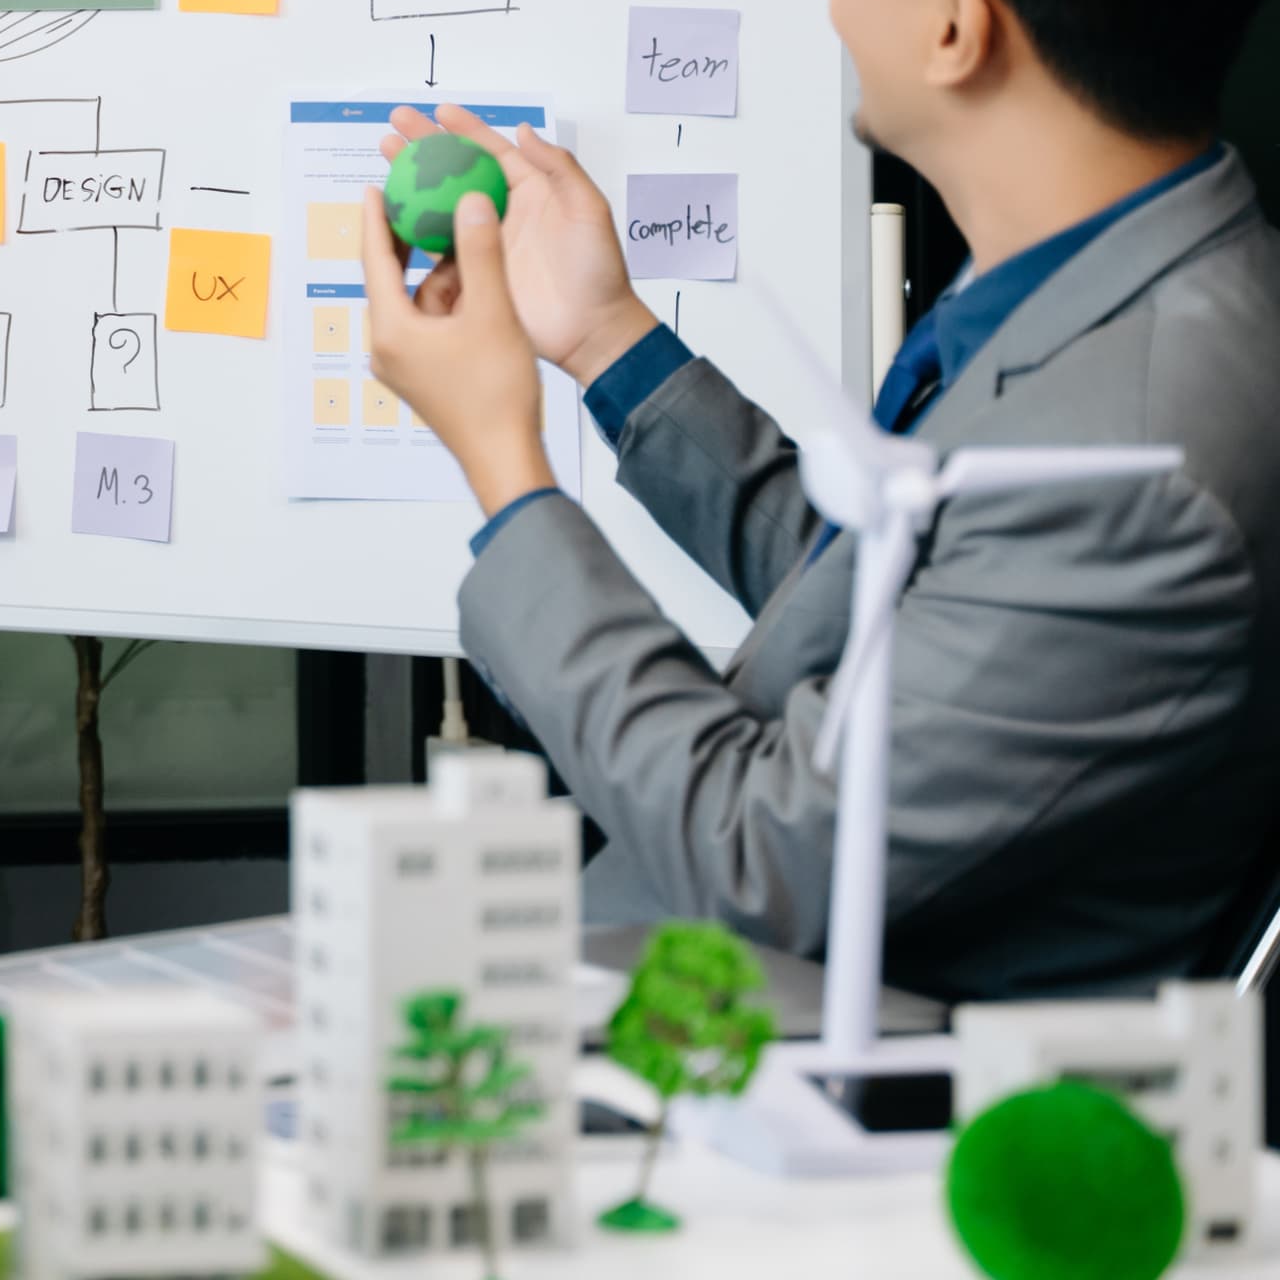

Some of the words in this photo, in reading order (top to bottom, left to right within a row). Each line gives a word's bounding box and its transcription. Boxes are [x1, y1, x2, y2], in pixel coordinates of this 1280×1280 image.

[641, 36, 730, 83] team
[628, 203, 735, 246] complete
[190, 271, 245, 303] UX
